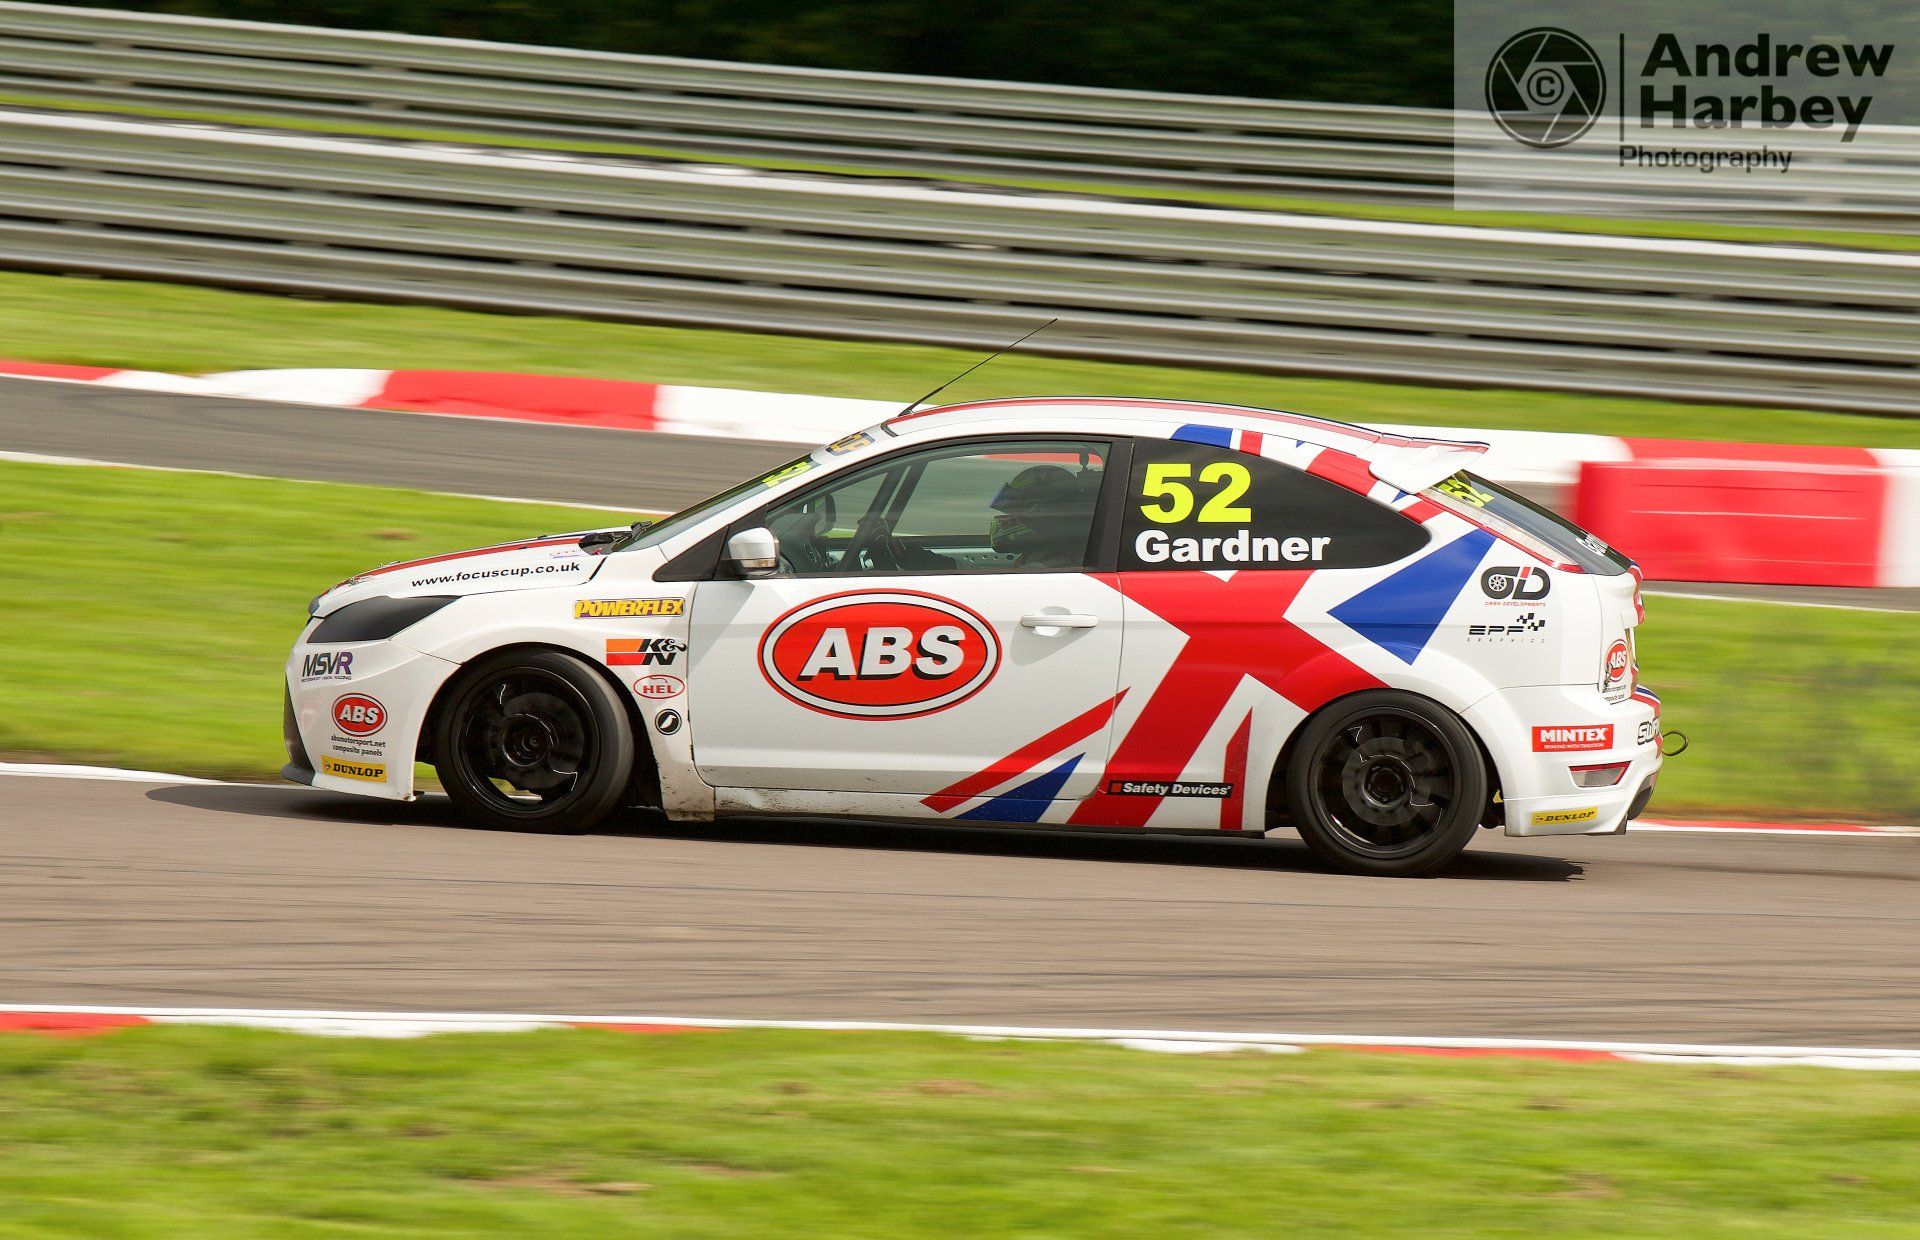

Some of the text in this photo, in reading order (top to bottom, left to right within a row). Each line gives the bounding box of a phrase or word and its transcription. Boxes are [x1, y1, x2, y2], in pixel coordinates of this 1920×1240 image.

[1140, 462, 1252, 524] 52
[1135, 529, 1332, 563] Gardner
[411, 562, 580, 587] www.focuscup.co.uk
[574, 598, 685, 619] POWERFLEX
[1469, 625, 1525, 636] EPF
[796, 625, 967, 681] ABS
[1610, 650, 1627, 669] ABS
[302, 651, 354, 677] MSVR
[642, 685, 676, 694] HEL
[338, 704, 380, 726] ABS
[330, 734, 386, 748] absmotorsport.net
[1540, 727, 1607, 742] MINTEX
[332, 744, 383, 757] composite panels
[333, 763, 384, 778] DUNLOP
[1122, 782, 1169, 795] Safety
[1544, 811, 1596, 822] DUNLOP
